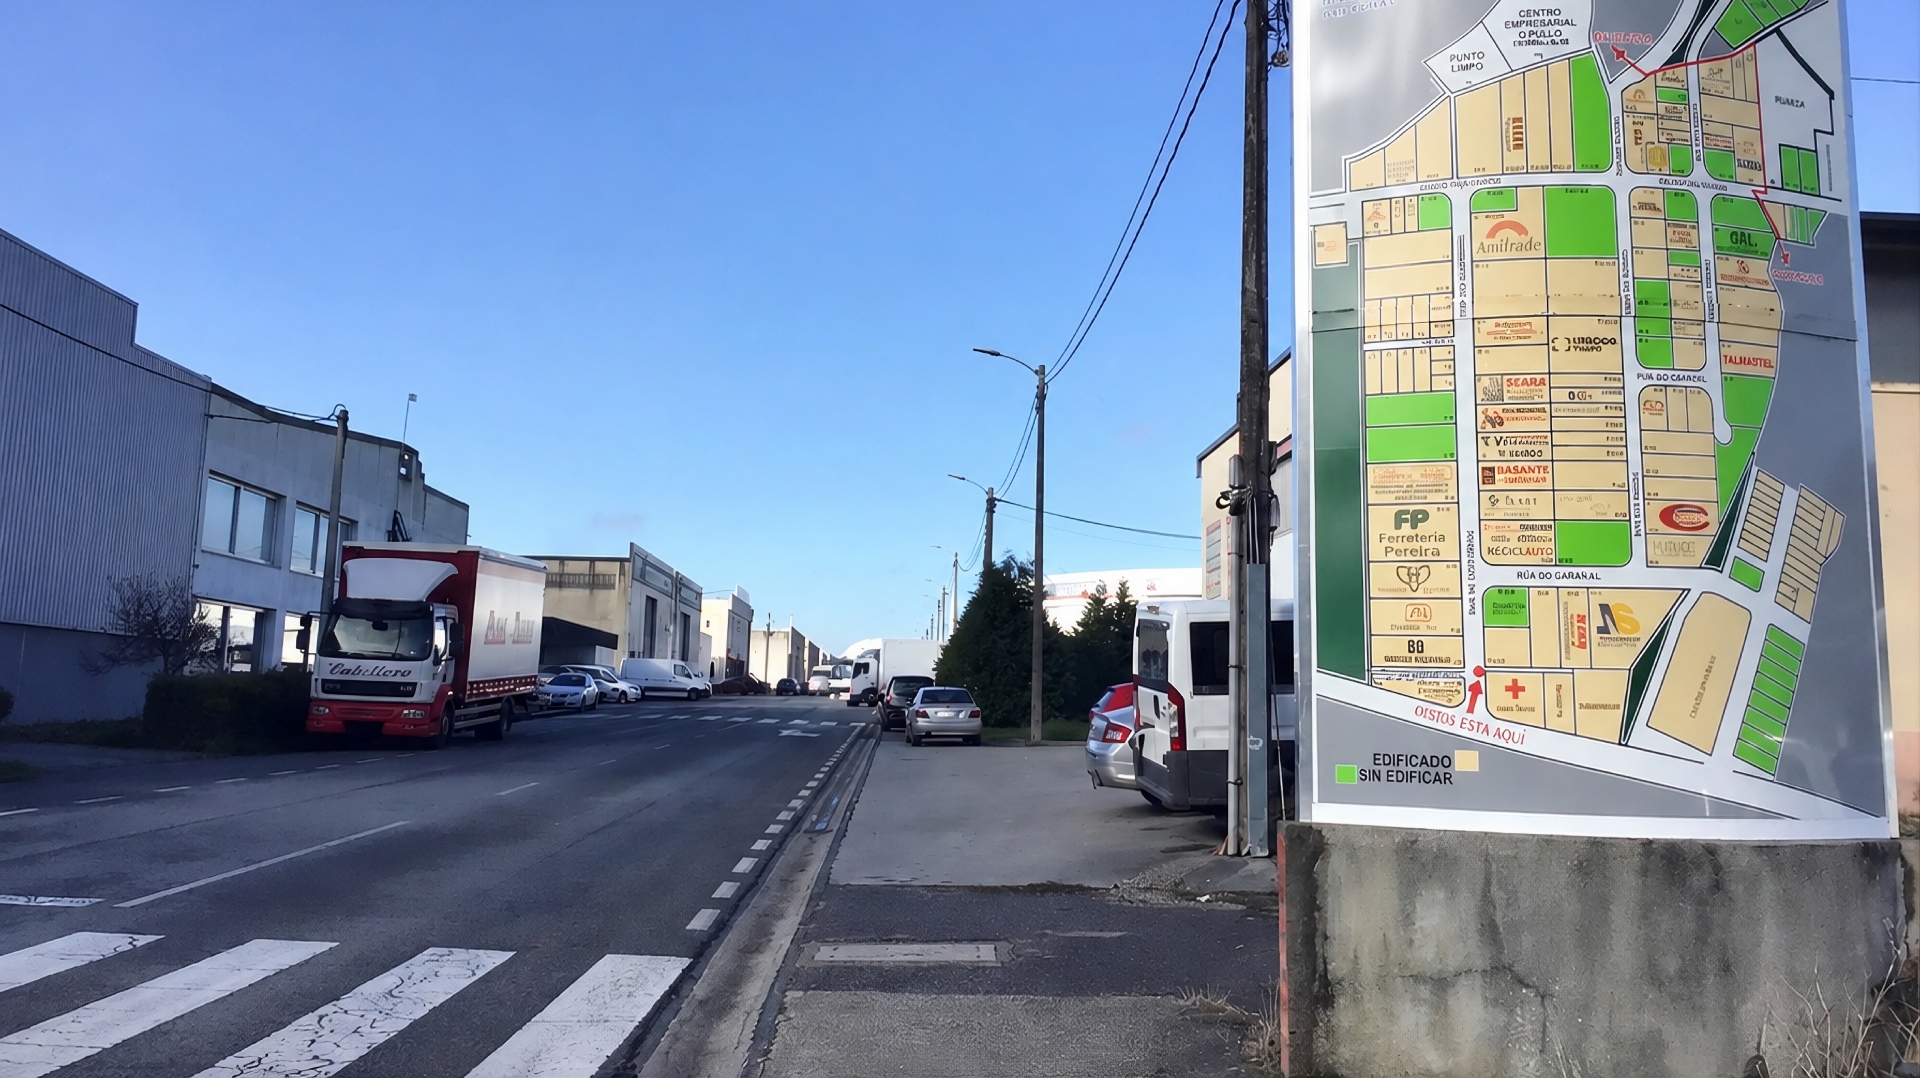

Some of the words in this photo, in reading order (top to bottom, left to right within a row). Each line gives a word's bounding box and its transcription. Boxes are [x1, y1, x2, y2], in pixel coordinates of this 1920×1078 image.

[1518, 8, 1562, 18] CENTRO
[1449, 51, 1485, 62] PUNTO
[1393, 508, 1430, 531] FP
[1384, 545, 1441, 558] Pereira
[1459, 716, 1490, 737] ESTA
[1372, 752, 1452, 769] EDIFICADO
[1358, 768, 1381, 782] SIN
[1386, 769, 1453, 785] EDIFICAR
